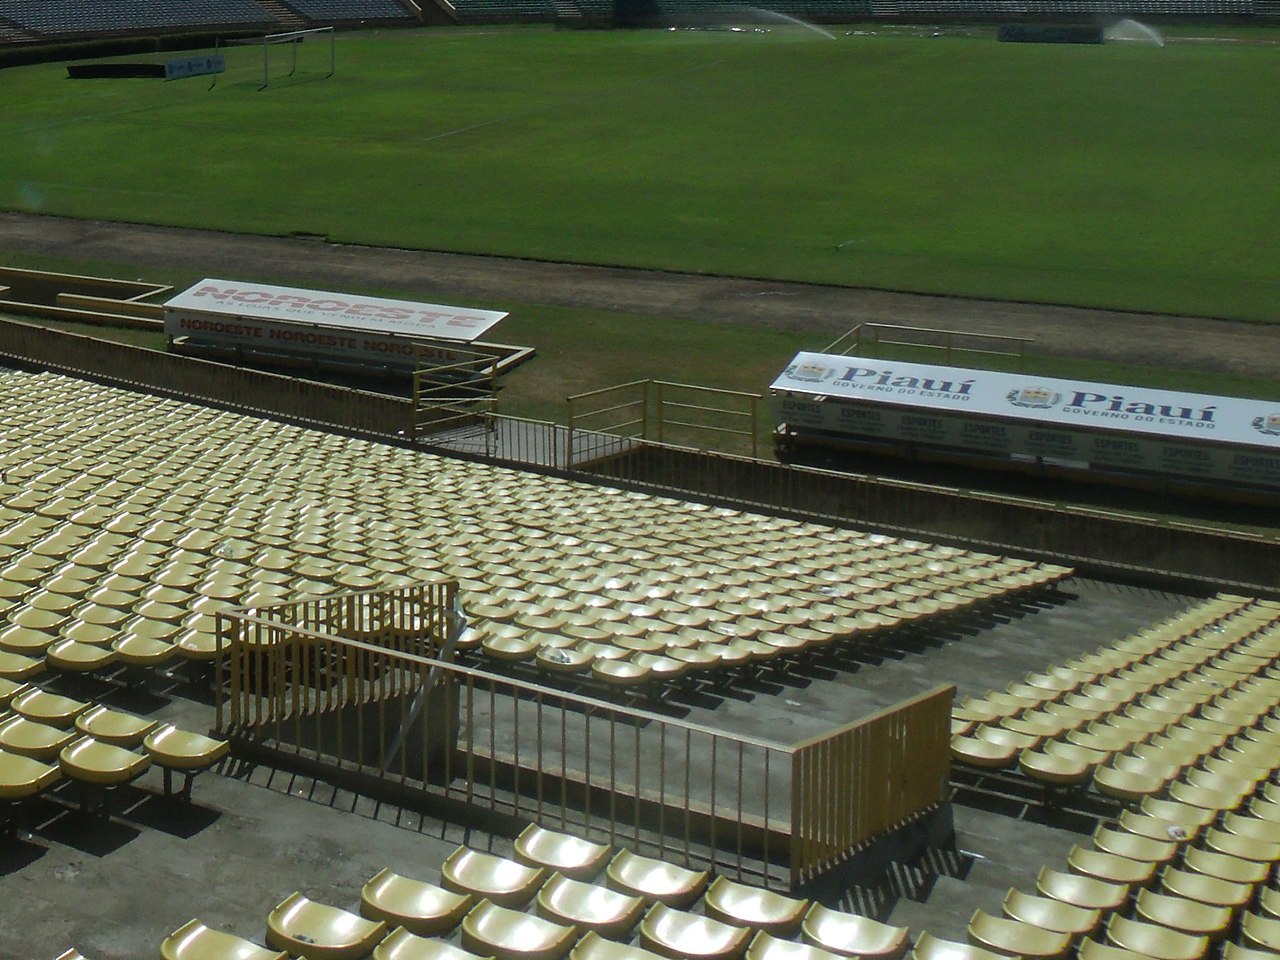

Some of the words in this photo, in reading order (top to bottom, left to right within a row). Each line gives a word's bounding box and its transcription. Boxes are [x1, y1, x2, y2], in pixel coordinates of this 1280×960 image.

[193, 286, 486, 328] NOROESTE
[179, 318, 263, 338] NOROESTE
[270, 328, 357, 349] NOROESTE
[832, 380, 893, 394] GOVERNO
[897, 388, 916, 396] DO
[919, 390, 971, 402] ESTADO
[837, 366, 976, 395] Piauí
[1062, 407, 1130, 420] GOVERNO
[1134, 414, 1155, 423] DO
[1158, 417, 1216, 430] ESTADO
[1066, 390, 1217, 423] Piauí
